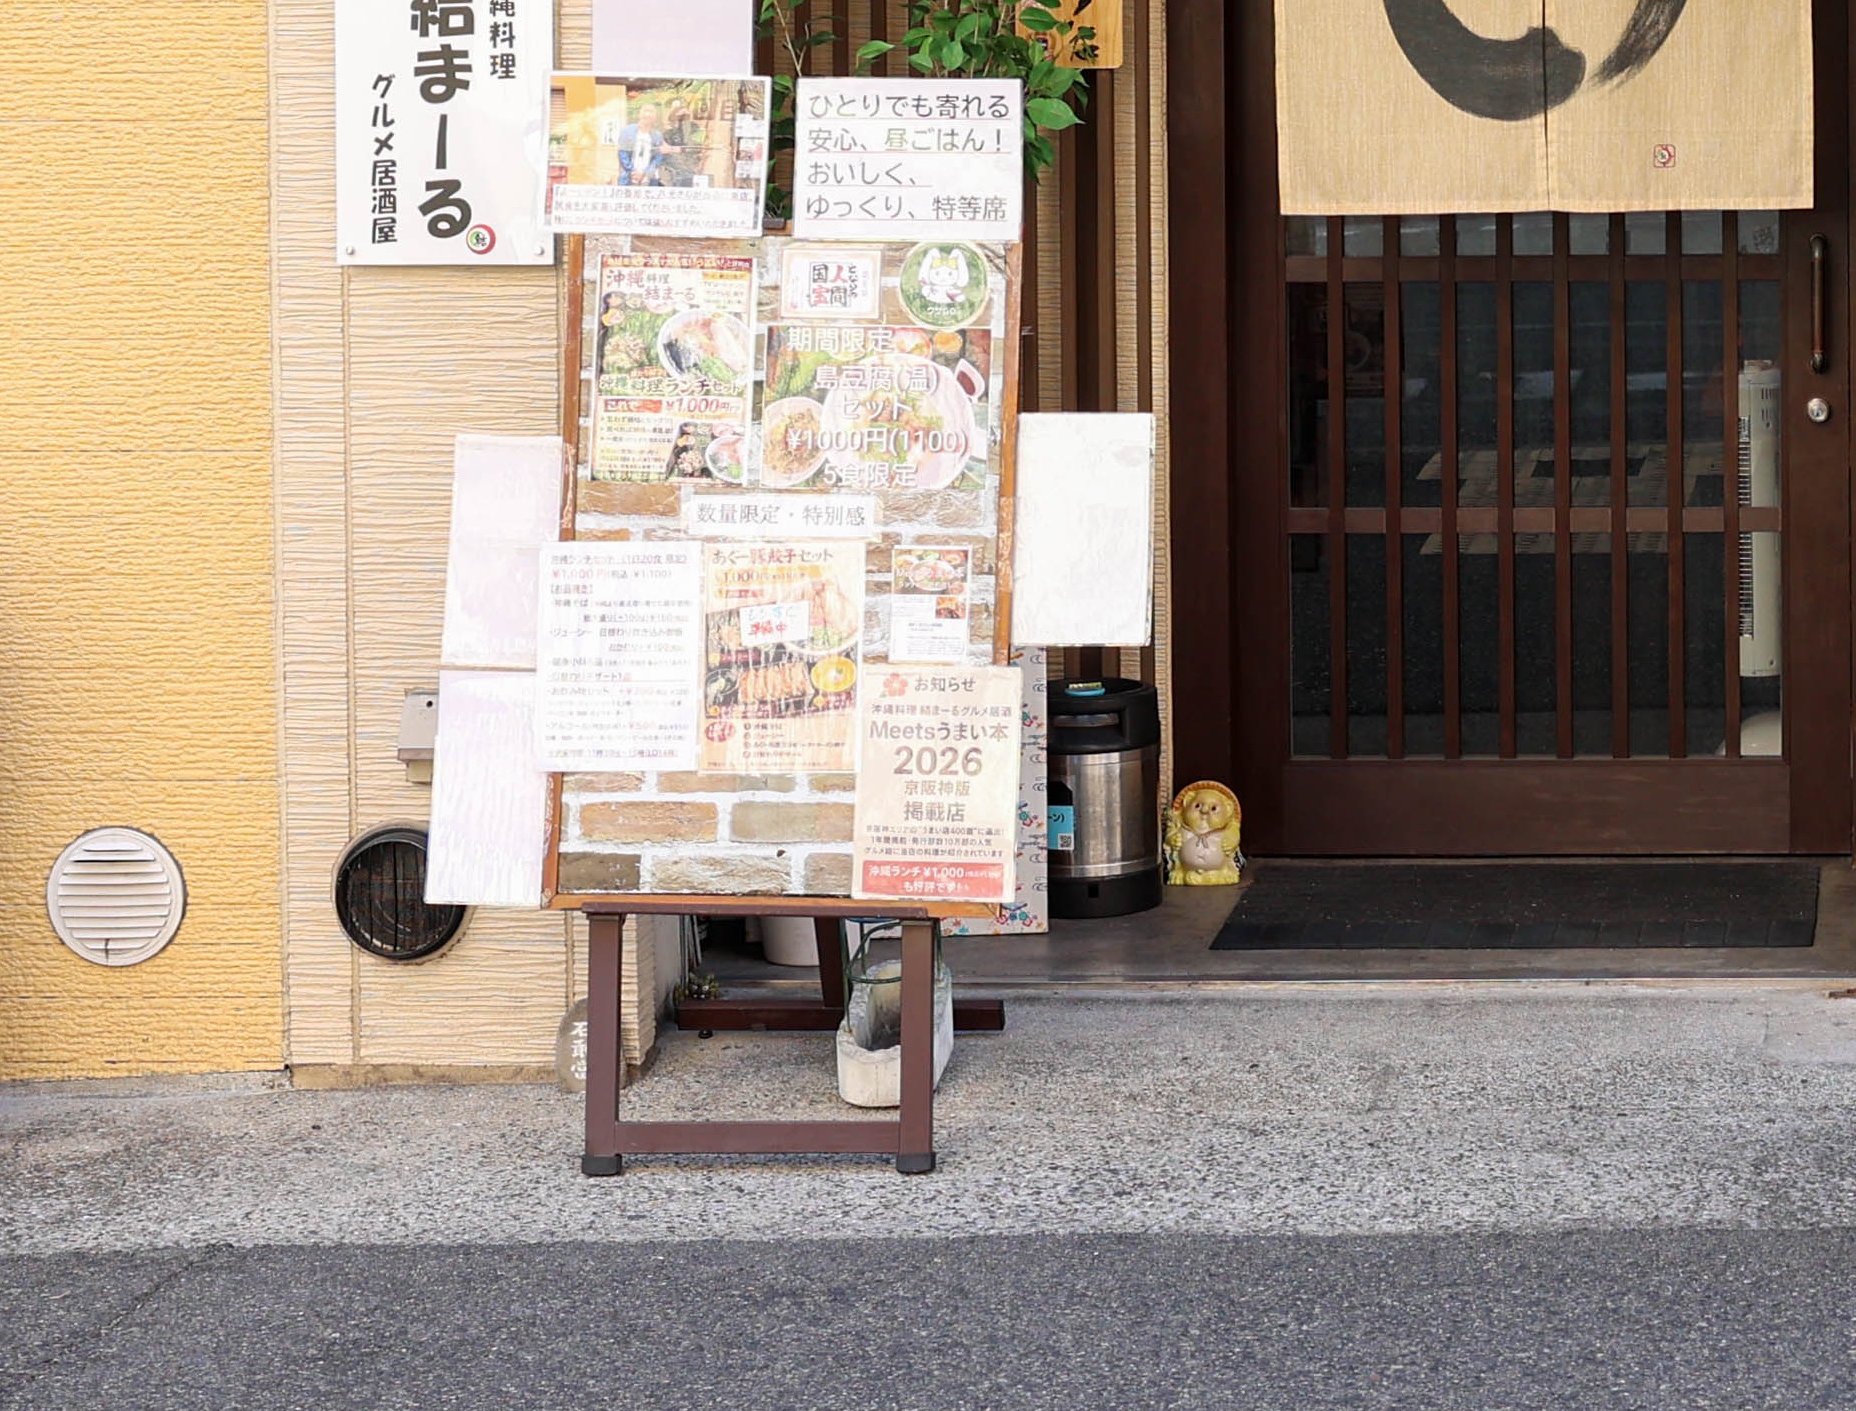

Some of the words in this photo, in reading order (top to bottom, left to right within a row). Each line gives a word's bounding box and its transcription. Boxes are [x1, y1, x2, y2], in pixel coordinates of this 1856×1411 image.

[809, 94, 1010, 119] ひとりでも寄れる
[371, 73, 398, 245] グルメ居酒屋
[807, 161, 917, 185] おいしく、
[806, 194, 1007, 221] ゆっくり、特等席
[787, 326, 895, 353] 期間限定
[842, 397, 913, 421] セット
[823, 463, 918, 489] 5食限定
[697, 502, 866, 527] 数量限定・特別感
[914, 676, 976, 692] お知らせ
[869, 720, 1010, 742] Meetsうまい本
[892, 745, 984, 776] 2026
[903, 780, 971, 797] 京阪神版
[903, 800, 966, 823] 掲載店
